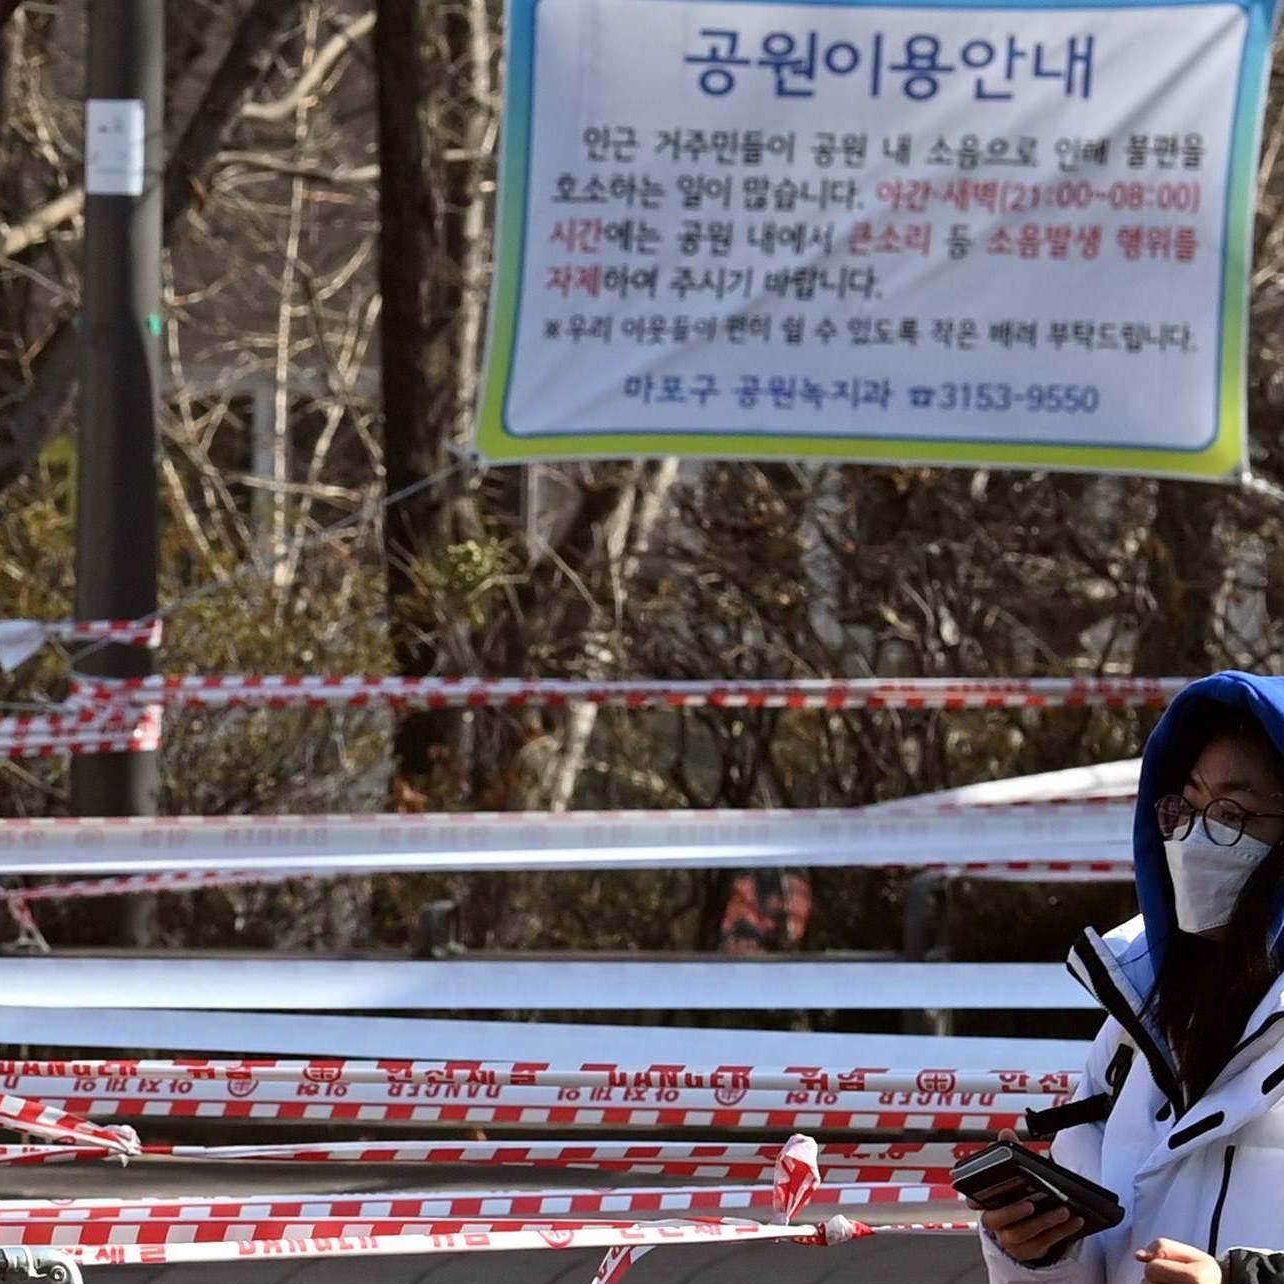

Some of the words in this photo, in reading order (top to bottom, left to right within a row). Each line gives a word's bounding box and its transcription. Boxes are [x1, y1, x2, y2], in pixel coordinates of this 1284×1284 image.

[684, 28, 1094, 103] 공원이용안내
[583, 126, 639, 163] 인근
[655, 128, 796, 166] 거주민들이
[812, 131, 868, 168] 공원
[882, 134, 912, 166] 내
[926, 134, 1037, 170] 소음으로
[551, 172, 666, 210] 호소하는
[677, 173, 732, 211] 일이
[742, 175, 864, 212] 많습니다.
[550, 218, 663, 255] 시간에는
[677, 220, 733, 257] 공원
[747, 221, 834, 257] 내에서
[848, 221, 931, 257] 큰소리
[946, 224, 973, 260] 등
[1117, 225, 1197, 262] 행위를
[546, 263, 659, 299] 자제하여
[670, 265, 754, 299] 주시기
[764, 265, 883, 300] 바랍니다.
[621, 313, 716, 344] 이웃들이
[815, 316, 837, 344] 수
[847, 317, 919, 347] 있도록
[623, 371, 718, 407] 마포구
[733, 374, 892, 412] 공원녹지과
